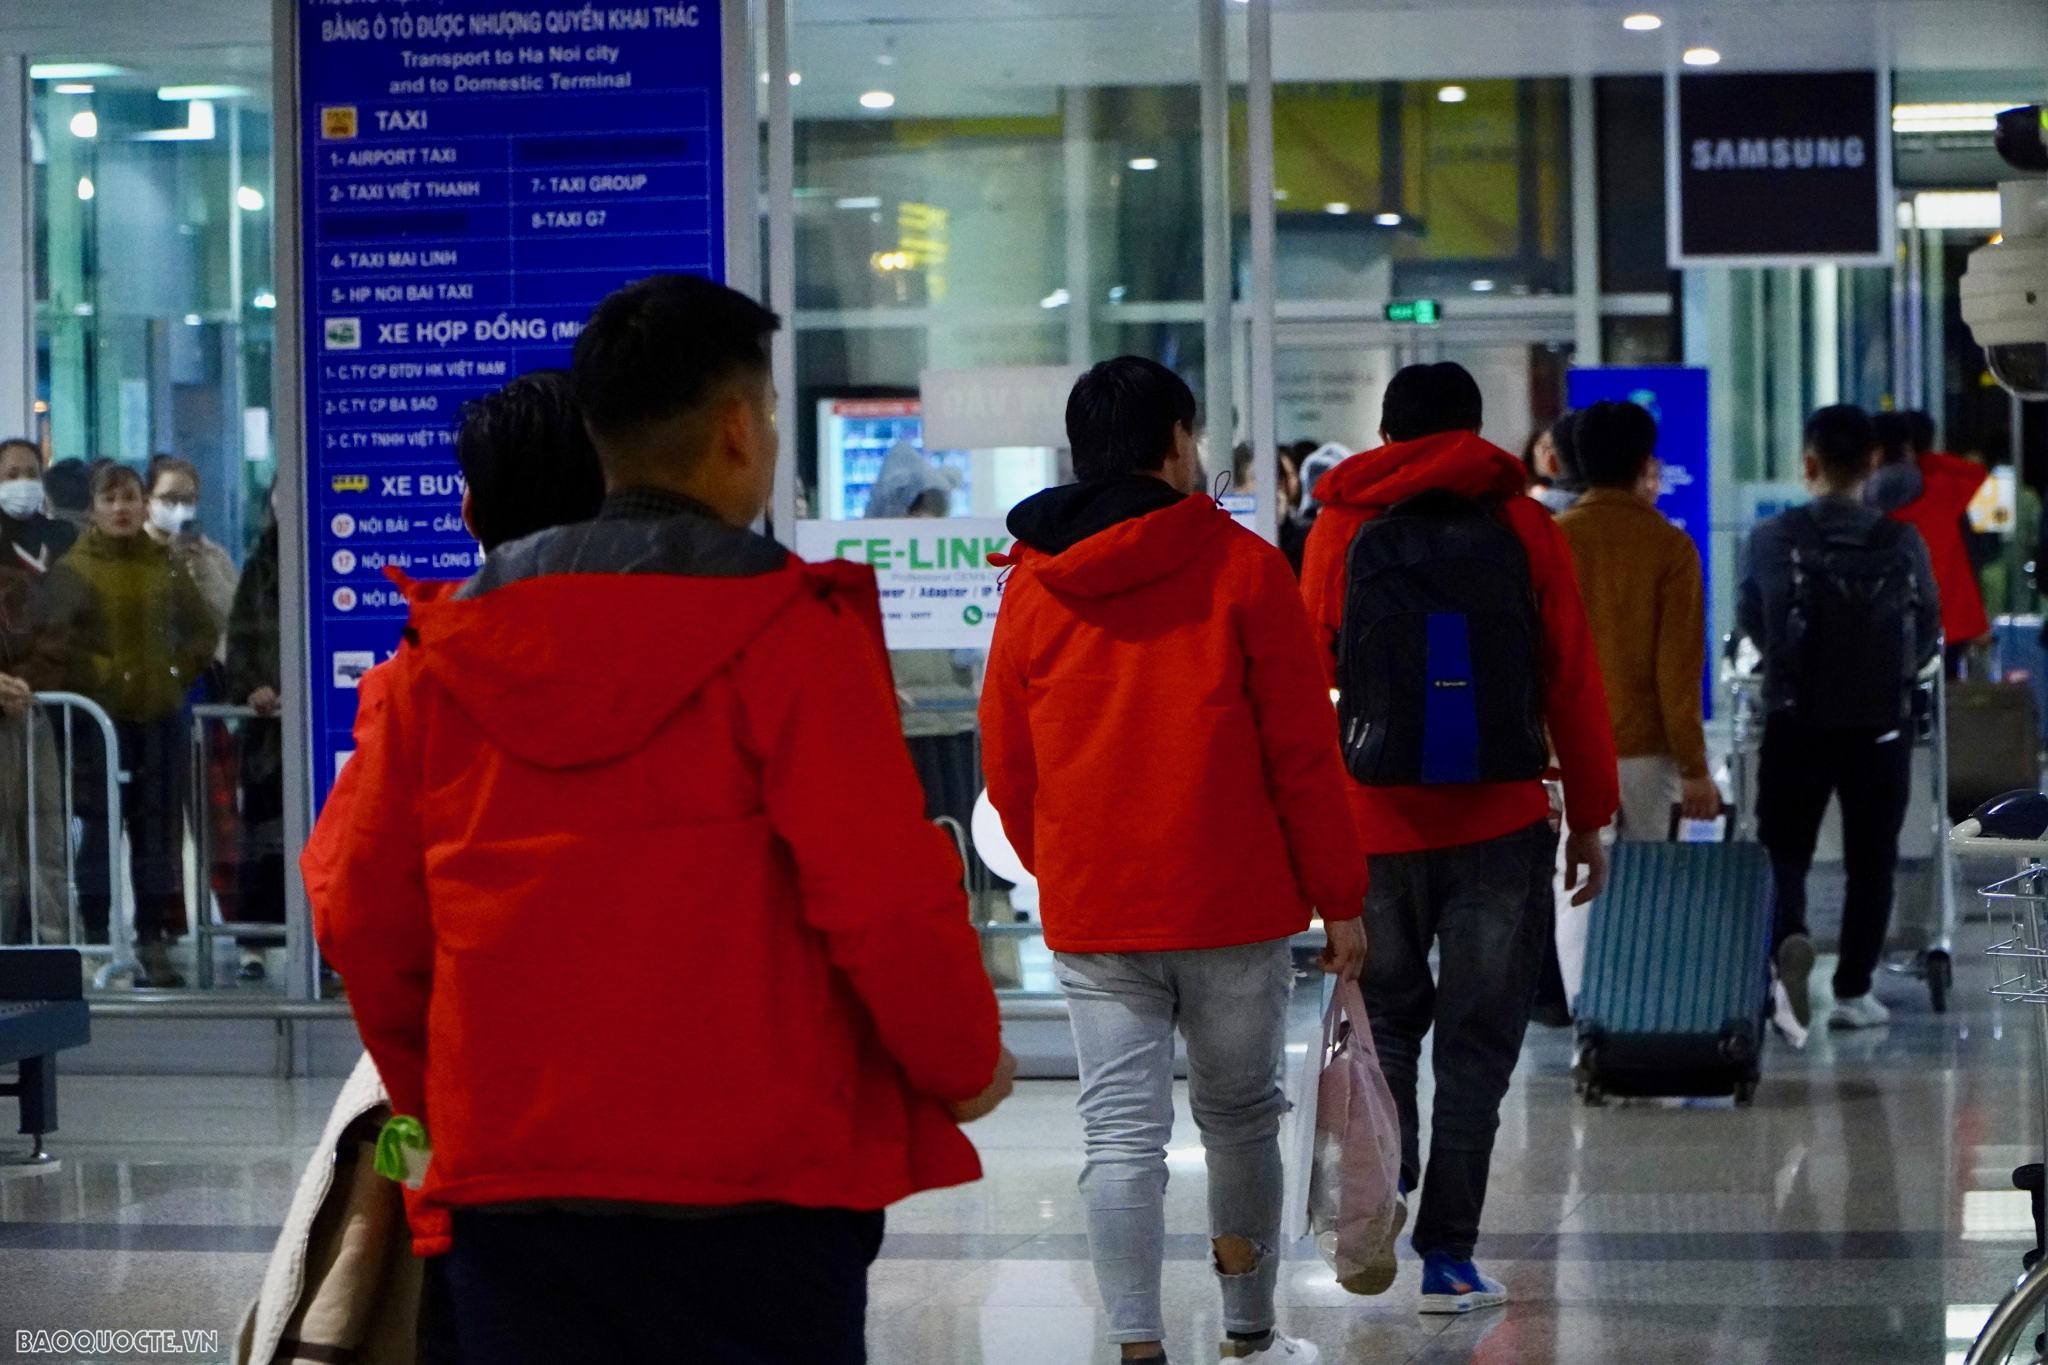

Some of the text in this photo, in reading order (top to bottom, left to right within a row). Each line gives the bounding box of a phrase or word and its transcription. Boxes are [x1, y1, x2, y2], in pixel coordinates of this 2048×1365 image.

[373, 12, 387, 39] Ô
[390, 11, 413, 39] TÔ
[608, 8, 649, 30] KHAI
[401, 44, 619, 70] Transport to Ha Noi city
[389, 71, 631, 94] and to Domestic Terminal
[374, 109, 427, 131] TAXI
[347, 148, 416, 166] AIRPORT
[419, 147, 456, 164] TAXI
[1691, 136, 1864, 171] SAMSUNG
[348, 183, 383, 200] TAXI
[386, 179, 420, 201] VIỆT
[426, 181, 480, 197] THANH
[550, 177, 586, 193] TAXI
[589, 174, 647, 192] GROUP
[586, 210, 606, 227] G7
[349, 252, 384, 268] TAXI
[388, 251, 417, 267] MAI
[420, 250, 457, 267] LINH
[437, 283, 474, 300] TAXI
[378, 323, 409, 344] XE
[416, 321, 467, 348] HỢP
[475, 313, 547, 342] ĐỒNG
[369, 365, 386, 379] CP
[448, 358, 473, 379] VIỆT
[477, 361, 506, 376] NAM
[370, 397, 386, 412] CP
[389, 397, 408, 412] BA
[407, 423, 434, 448] VIỆT
[381, 476, 412, 496] XE
[359, 517, 382, 534] NỘI
[362, 552, 385, 570] NỘI
[432, 552, 471, 568] LONG
[362, 589, 387, 607] NỘI
[919, 587, 968, 599] Adapter
